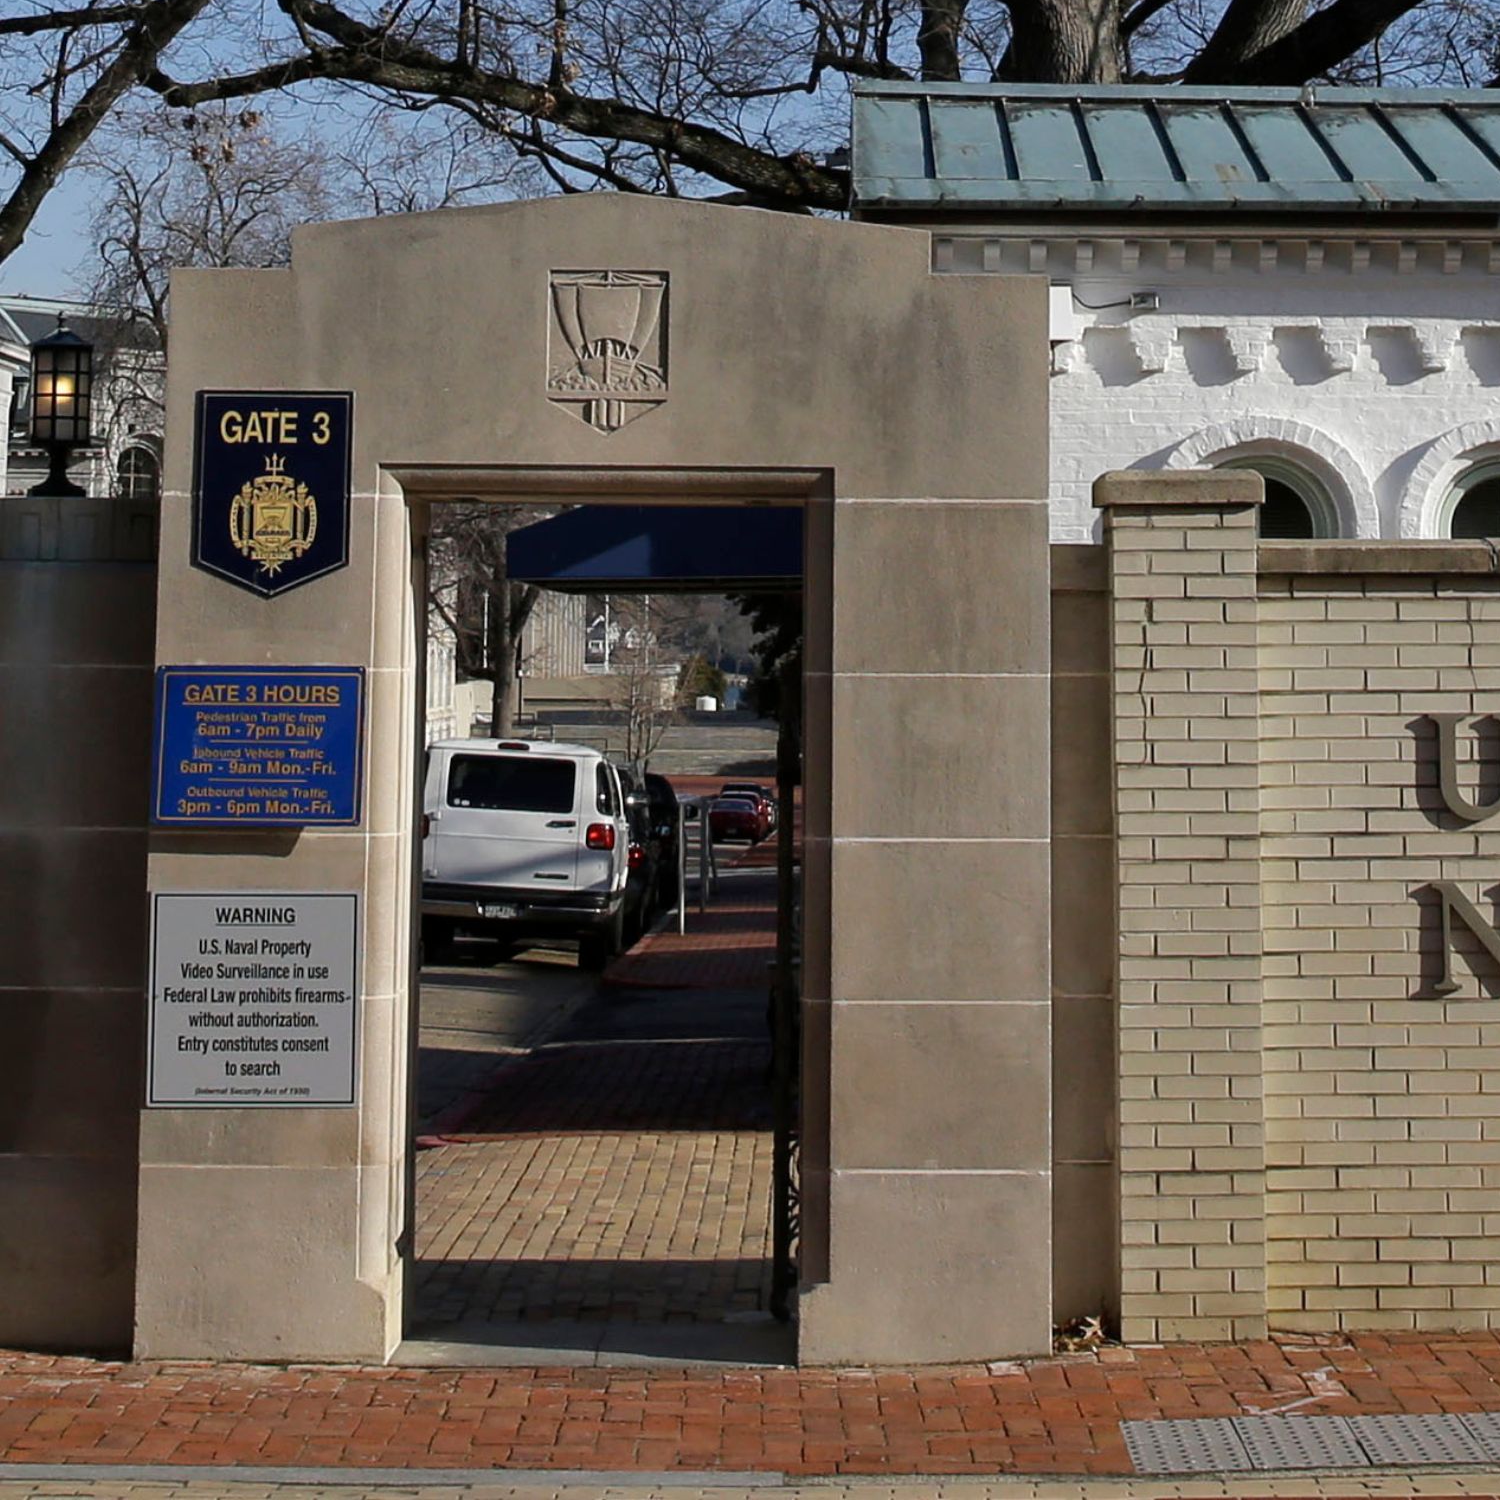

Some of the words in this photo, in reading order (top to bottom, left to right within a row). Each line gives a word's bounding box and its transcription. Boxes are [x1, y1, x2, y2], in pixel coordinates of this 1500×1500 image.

[220, 410, 298, 444] GATE
[312, 411, 330, 445] 3
[185, 684, 239, 703] GATE
[246, 686, 256, 703] 3
[263, 686, 340, 703] HOURS
[196, 711, 257, 723] Pedestrian
[261, 711, 296, 723] Traffic
[299, 712, 326, 723] from
[197, 723, 230, 737] 6am
[246, 724, 280, 740] 7pm
[285, 724, 324, 740] Daily
[193, 747, 241, 759] Inbound
[245, 747, 285, 759] Vehicle
[288, 748, 324, 760] Traffic
[180, 760, 213, 774] 6am
[229, 761, 261, 775] 9am
[187, 786, 244, 798] Outbound
[248, 786, 288, 798] Vehicle
[292, 787, 328, 799] Traffic
[177, 799, 211, 815] 3pm
[227, 799, 260, 816] 6pm
[216, 907, 296, 924] WARNING
[199, 939, 222, 955] U.S.
[225, 939, 258, 955] Naval
[261, 939, 312, 958] Property
[181, 963, 213, 979] Video
[216, 963, 290, 979] Surveillance
[293, 963, 304, 979] in
[307, 967, 329, 979] use
[163, 987, 207, 1003] Federal
[210, 988, 235, 1004] Law
[238, 987, 292, 1006] prohibits
[188, 1011, 234, 1028] without
[237, 1011, 319, 1028] authorization.
[178, 1035, 209, 1055] Entry
[212, 1036, 278, 1052] constitutes
[282, 1036, 329, 1052] consent
[225, 1060, 237, 1076] to
[240, 1060, 280, 1076] search
[229, 1087, 261, 1097] Security
[262, 1087, 277, 1096] Act
[278, 1087, 288, 1096] of
